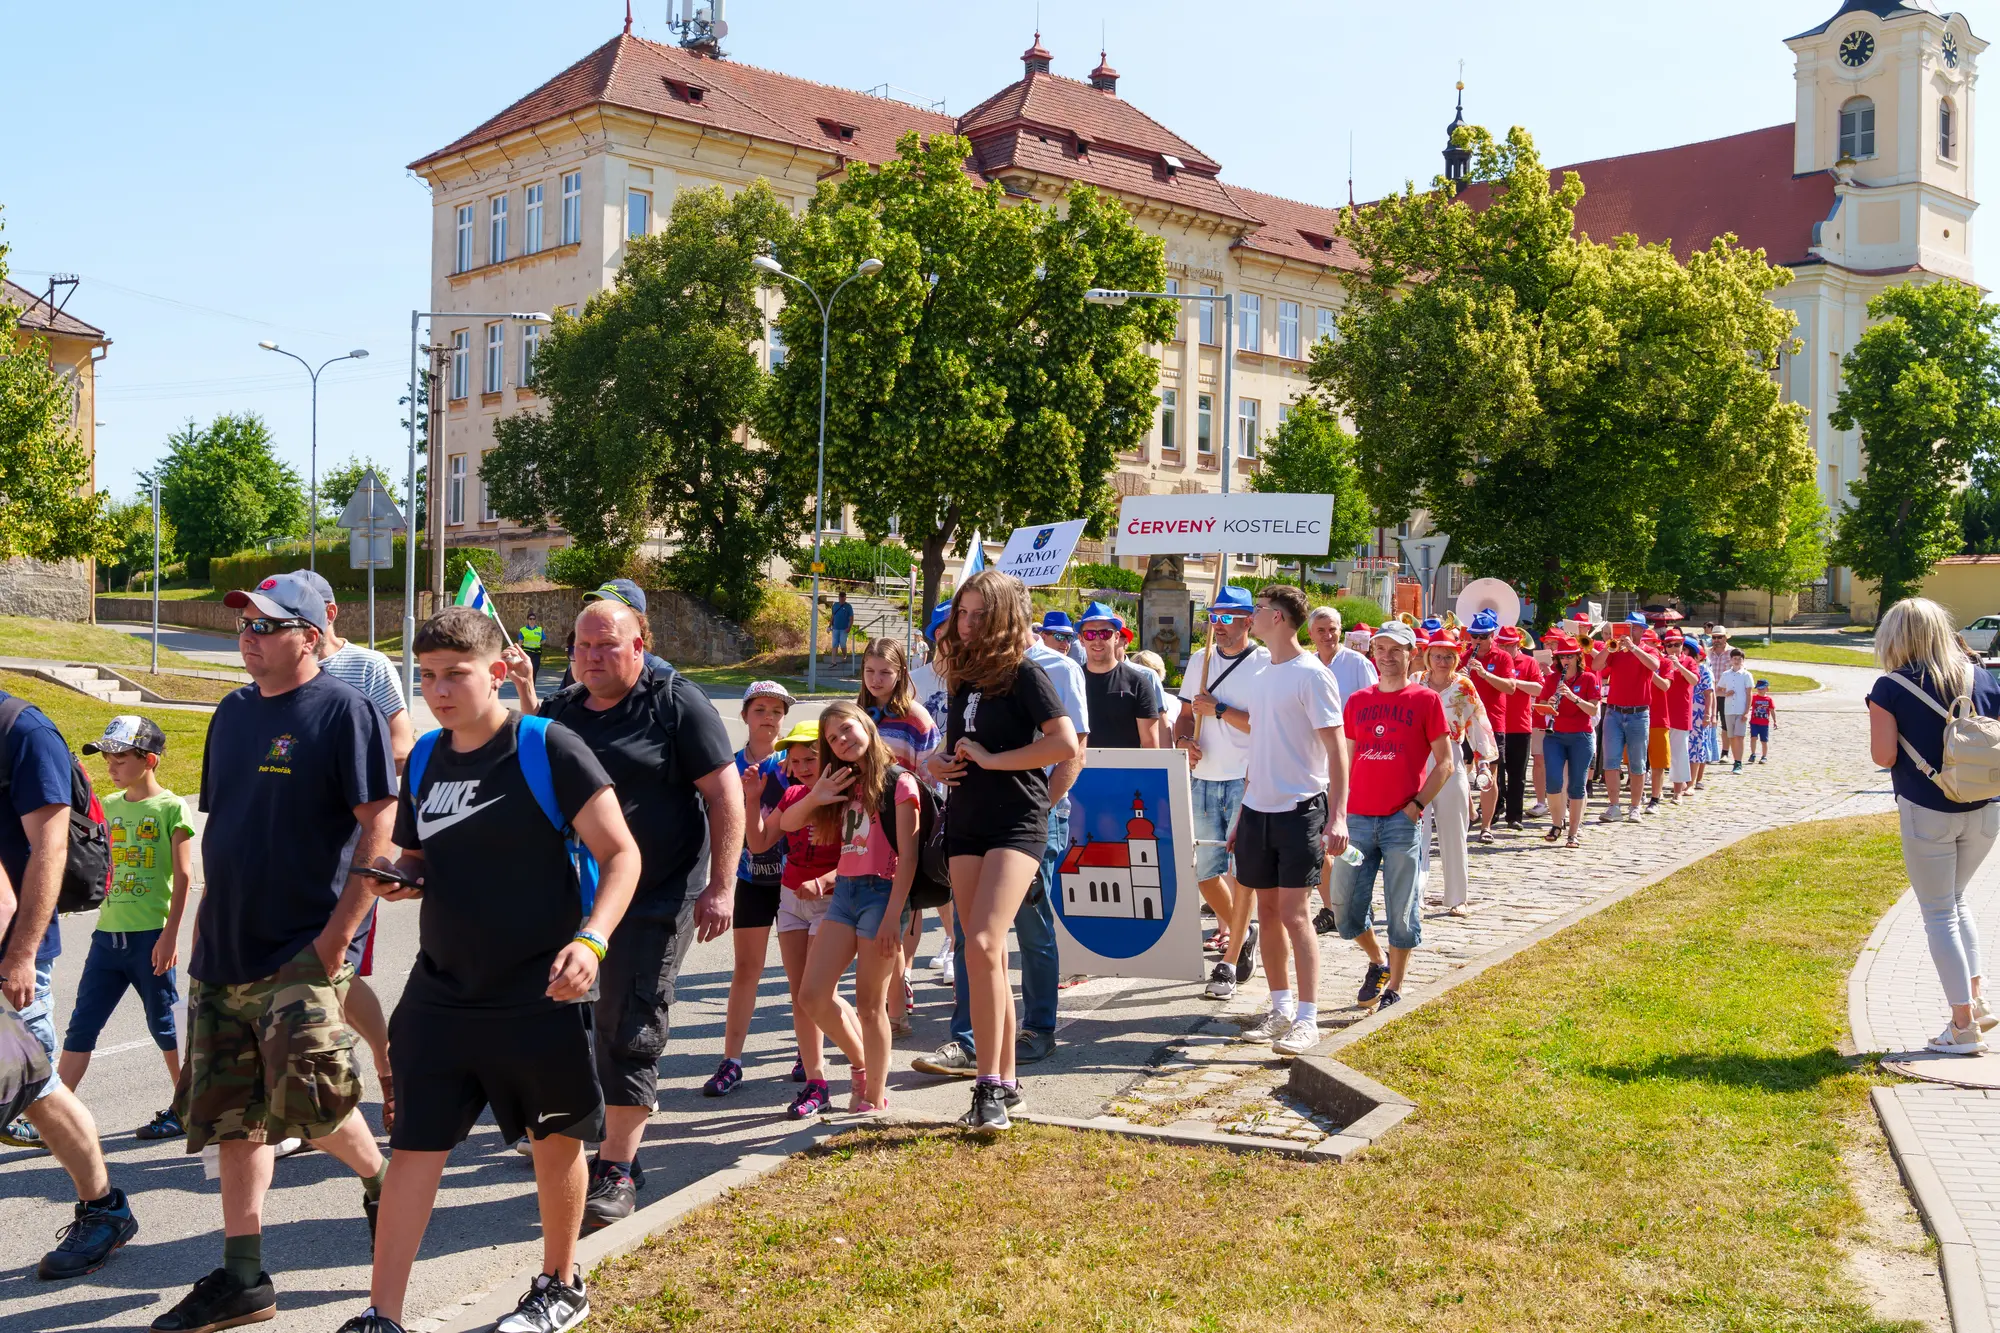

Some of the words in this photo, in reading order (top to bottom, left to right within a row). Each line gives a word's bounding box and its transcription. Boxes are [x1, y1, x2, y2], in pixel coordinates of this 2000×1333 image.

[1127, 517, 1217, 535] ČERVENÝ
[1223, 519, 1321, 534] KOSTELEC
[1015, 549, 1062, 565] KRNOV
[269, 765, 292, 775] Dvořák
[422, 779, 481, 814] NIKE
[747, 862, 782, 876] WEDNESD
